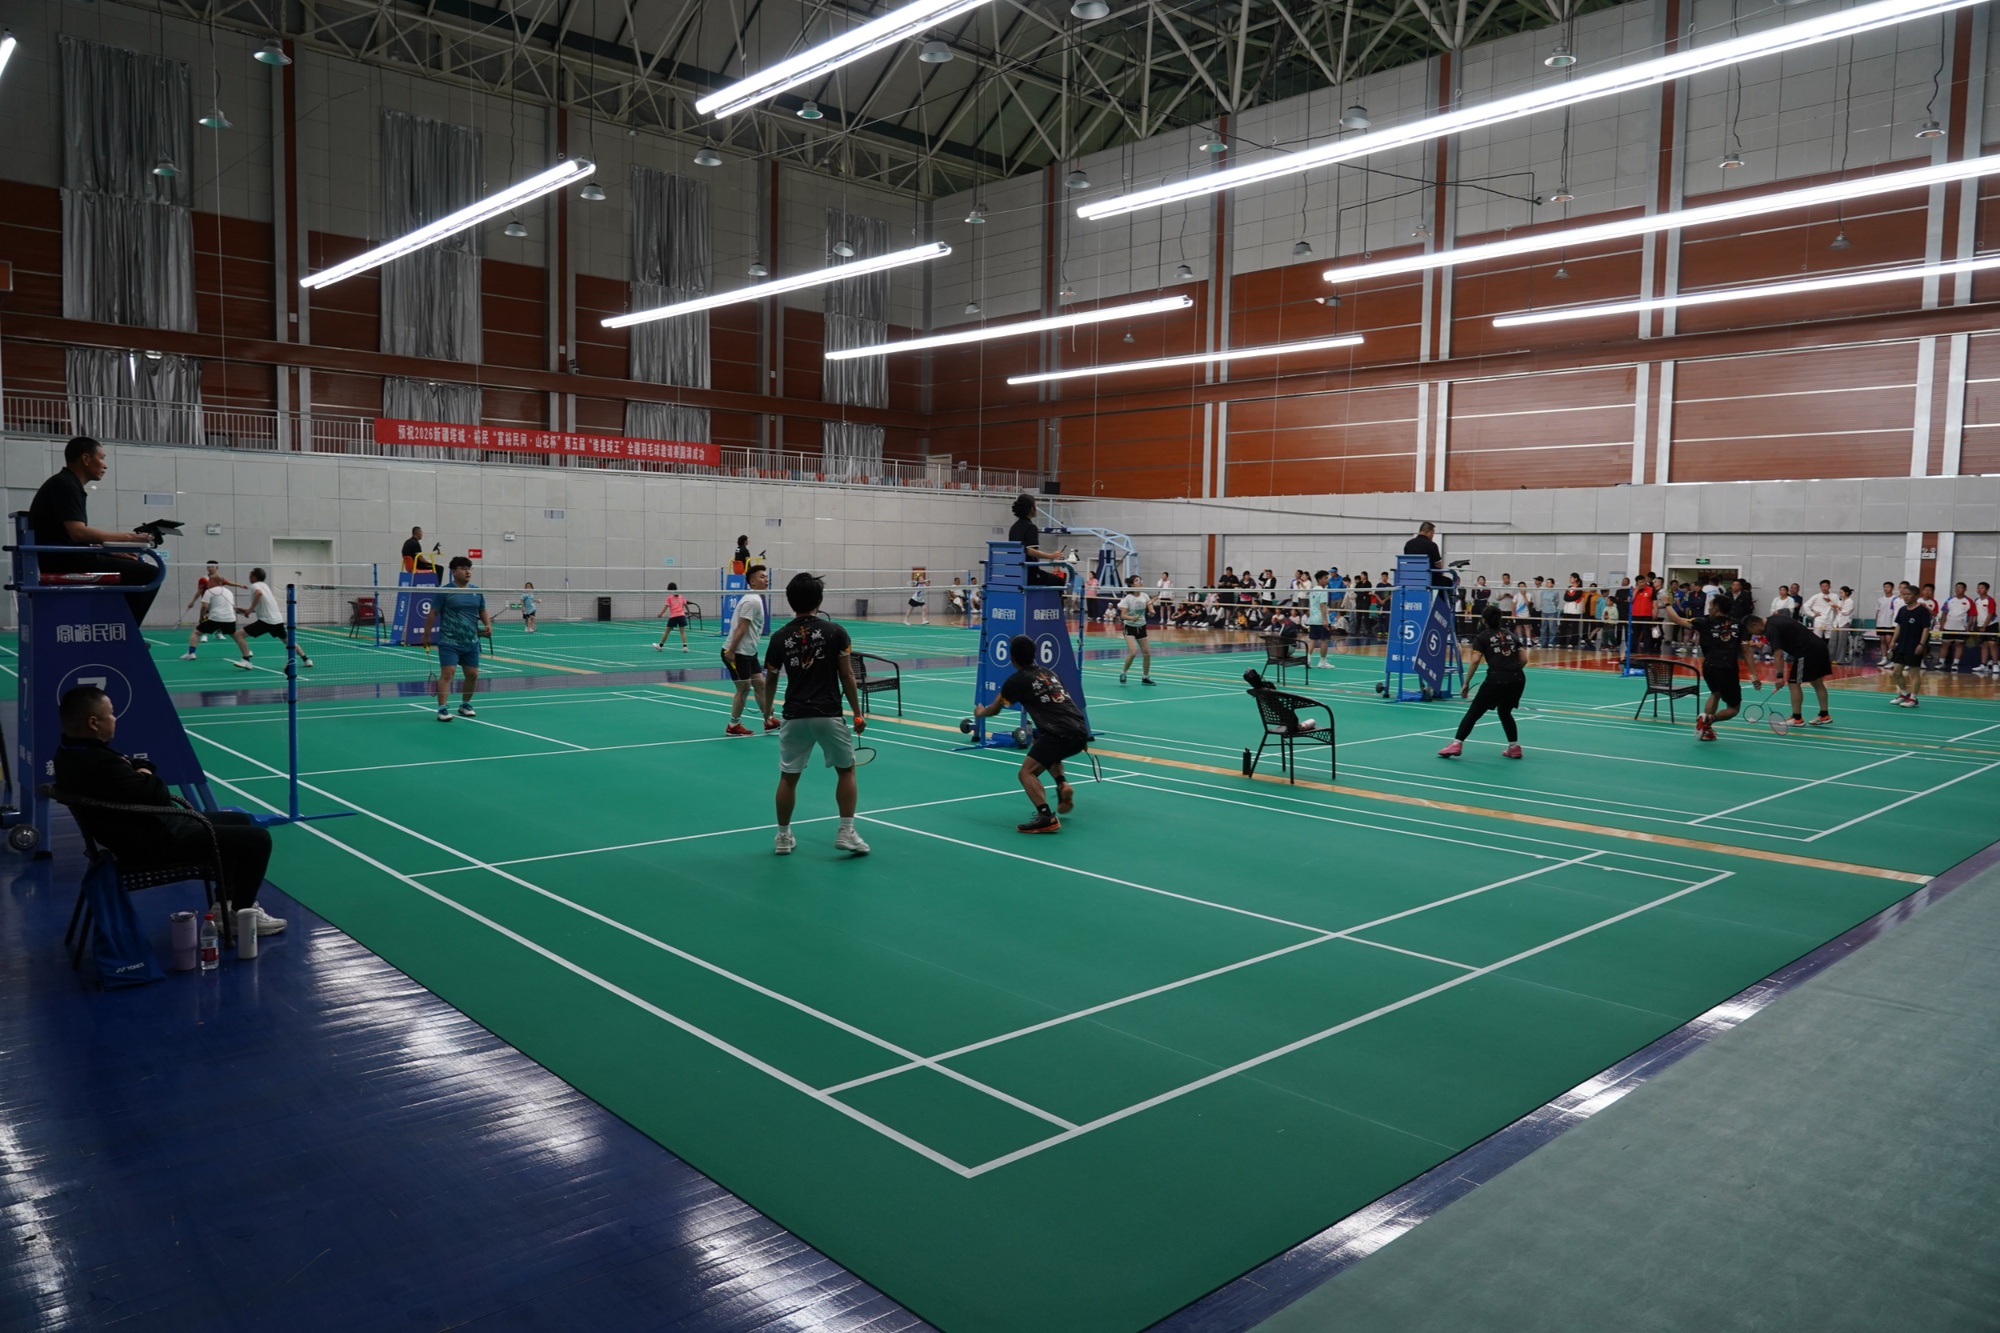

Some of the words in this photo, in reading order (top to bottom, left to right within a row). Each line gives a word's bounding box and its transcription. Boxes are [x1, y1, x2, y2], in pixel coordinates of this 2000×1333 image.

[422, 602, 431, 614] 9
[1404, 625, 1415, 640] 5
[996, 640, 1007, 660] 6
[1429, 634, 1438, 651] 5
[1040, 641, 1053, 663] 6
